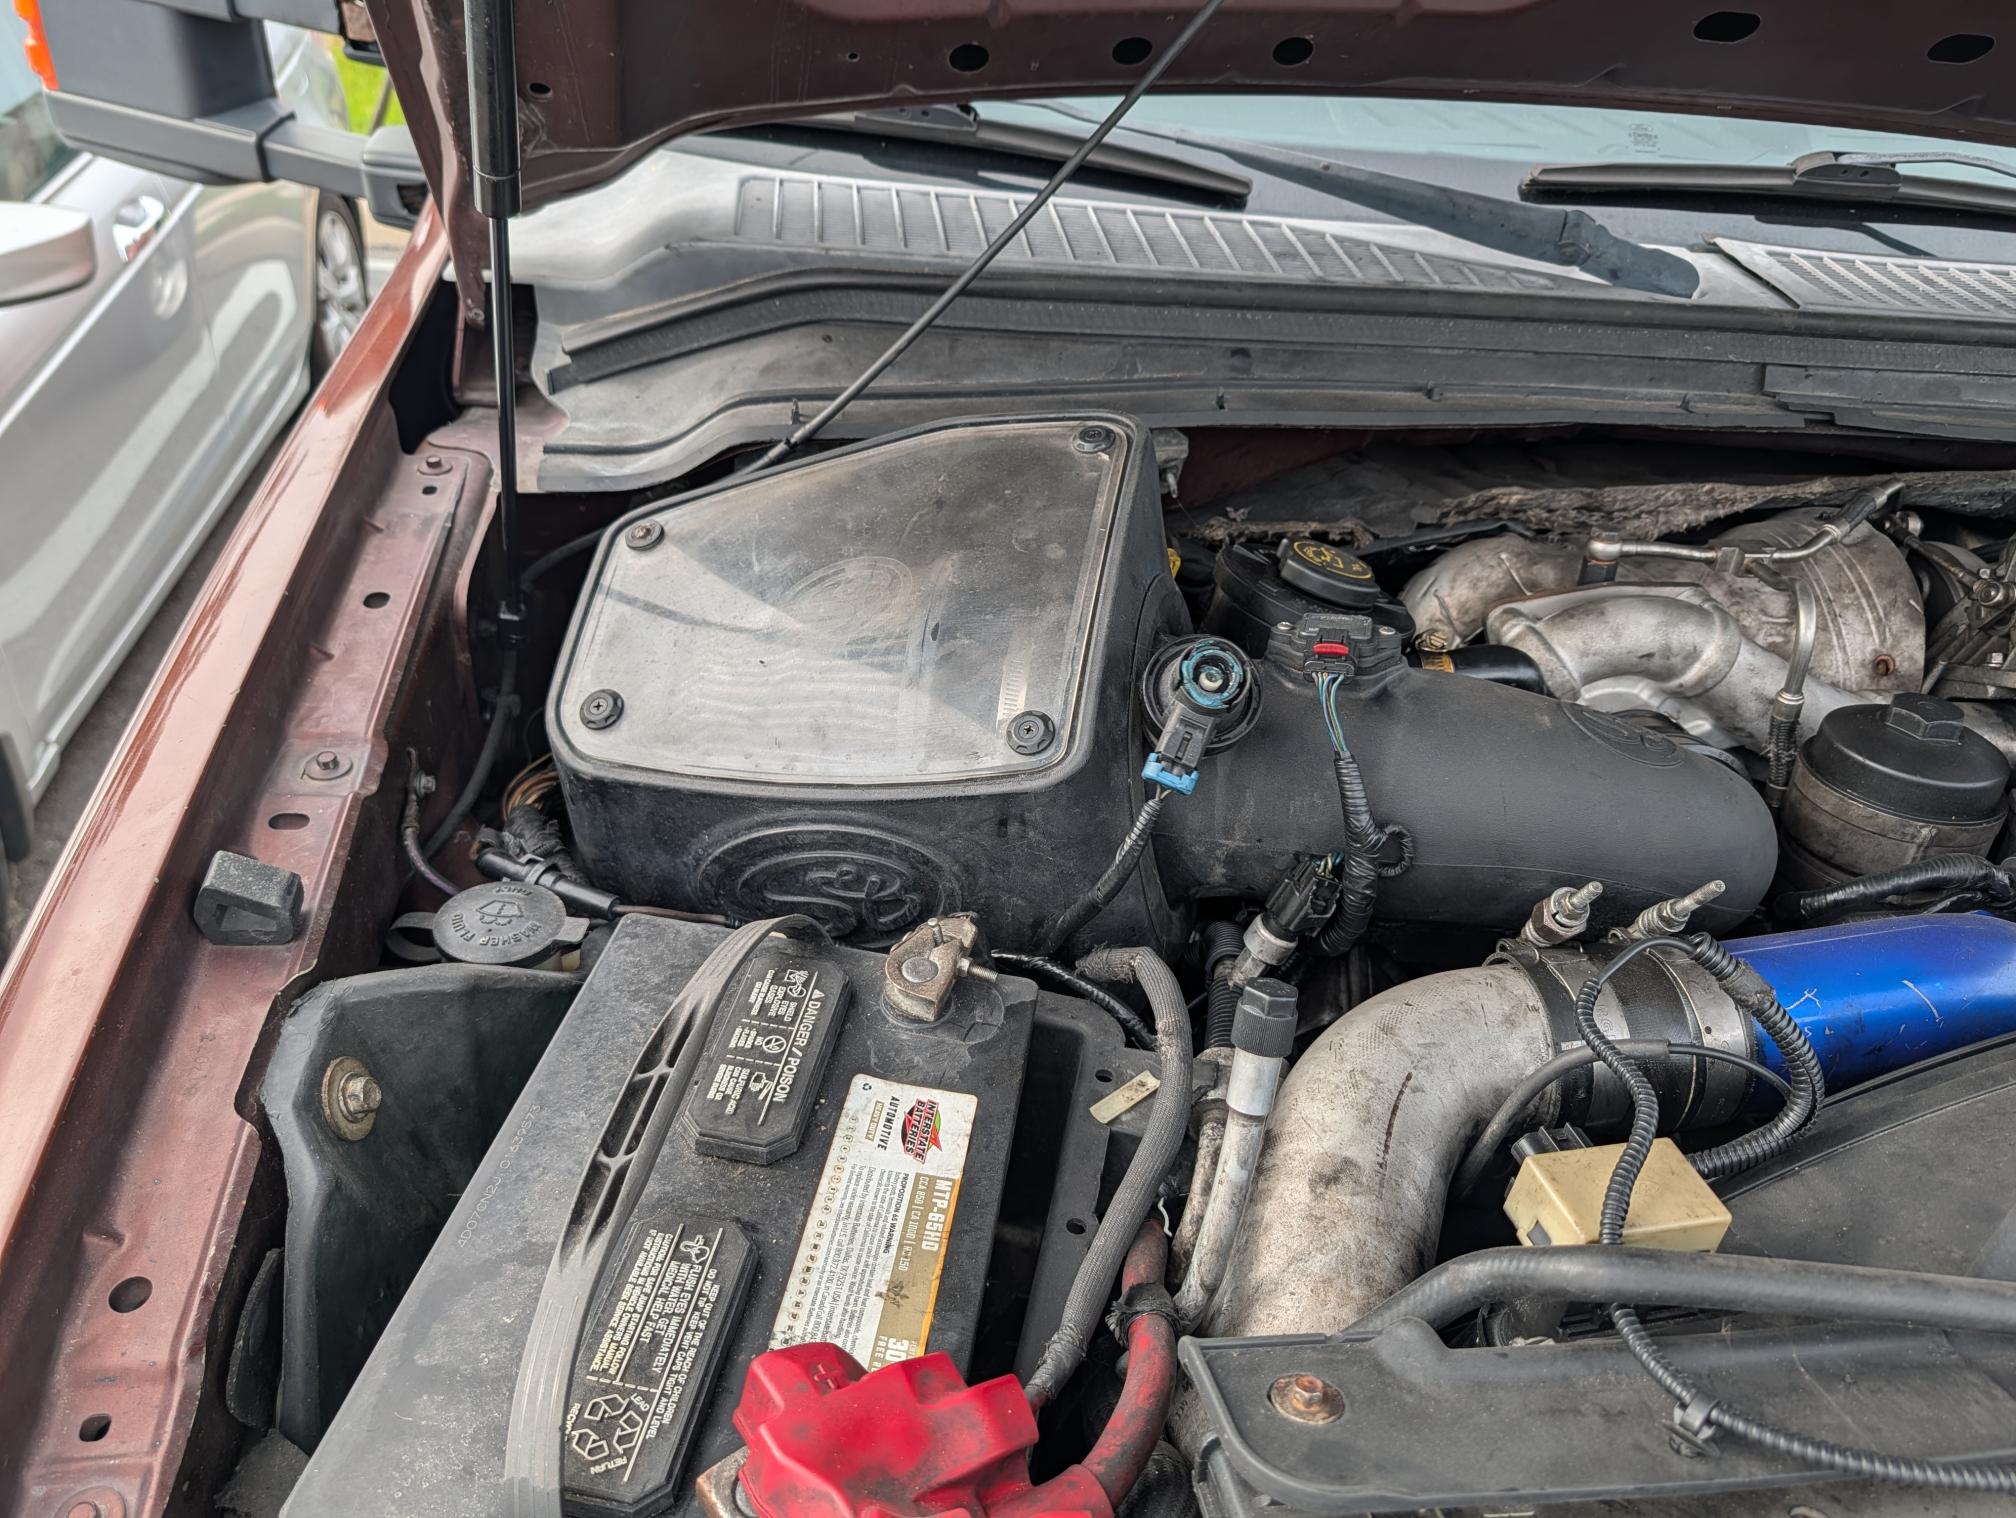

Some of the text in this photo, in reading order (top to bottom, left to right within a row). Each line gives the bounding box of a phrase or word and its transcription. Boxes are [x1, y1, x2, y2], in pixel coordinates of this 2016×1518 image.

[451, 912, 476, 942] FLUID
[480, 920, 542, 946] WASHER
[767, 985, 786, 1016] EXPLOSIVE
[777, 1000, 789, 1015] EYES
[783, 1001, 797, 1021] SHIELD
[796, 1001, 821, 1046] DANGER
[753, 1036, 763, 1045] NO
[724, 1067, 750, 1114] SULFURIC ACID
[773, 1056, 801, 1103] POISON
[866, 1102, 882, 1138] HEAVY DUTY
[876, 1095, 900, 1150] AUTOMOTIVE
[904, 1100, 925, 1153] BATTERIES
[914, 1100, 937, 1159] INTERSTATE
[917, 1176, 929, 1189] CCA
[854, 1199, 867, 1222] Interstate
[913, 1190, 925, 1204] 850
[882, 1172, 909, 1254] PROPOSITION 65 WARNING
[910, 1210, 921, 1220] CA
[920, 1179, 952, 1251] MTP-65HD
[905, 1220, 918, 1239] 1000
[627, 1250, 648, 1282] AVAILABLE
[649, 1262, 661, 1276] FOR
[897, 1257, 909, 1271] 150
[620, 1283, 634, 1300] SEEK
[624, 1285, 642, 1312] VEHICLE
[641, 1277, 655, 1293] SAFE
[653, 1262, 692, 1335] WITH WATER. GET
[831, 1290, 841, 1302] USA
[608, 1300, 626, 1327] SERVICE
[638, 1260, 681, 1343] MEDICAL HELP FAST
[619, 1312, 640, 1345] STARTING
[649, 1264, 703, 1373] FLUSH EYES IMMEDIATELY
[607, 1346, 626, 1374] FOLLOW
[644, 1268, 717, 1439] DO NOT TIP KEEP VENT CAPS TIGHT AND LEVEL
[660, 1283, 720, 1424] KEEP OUT OF THE REACH OF CHILDREN
[873, 1335, 887, 1358] FREE
[884, 1337, 909, 1363] 30
[630, 1393, 650, 1411] LEAD
[590, 1456, 627, 1474] RETURN
